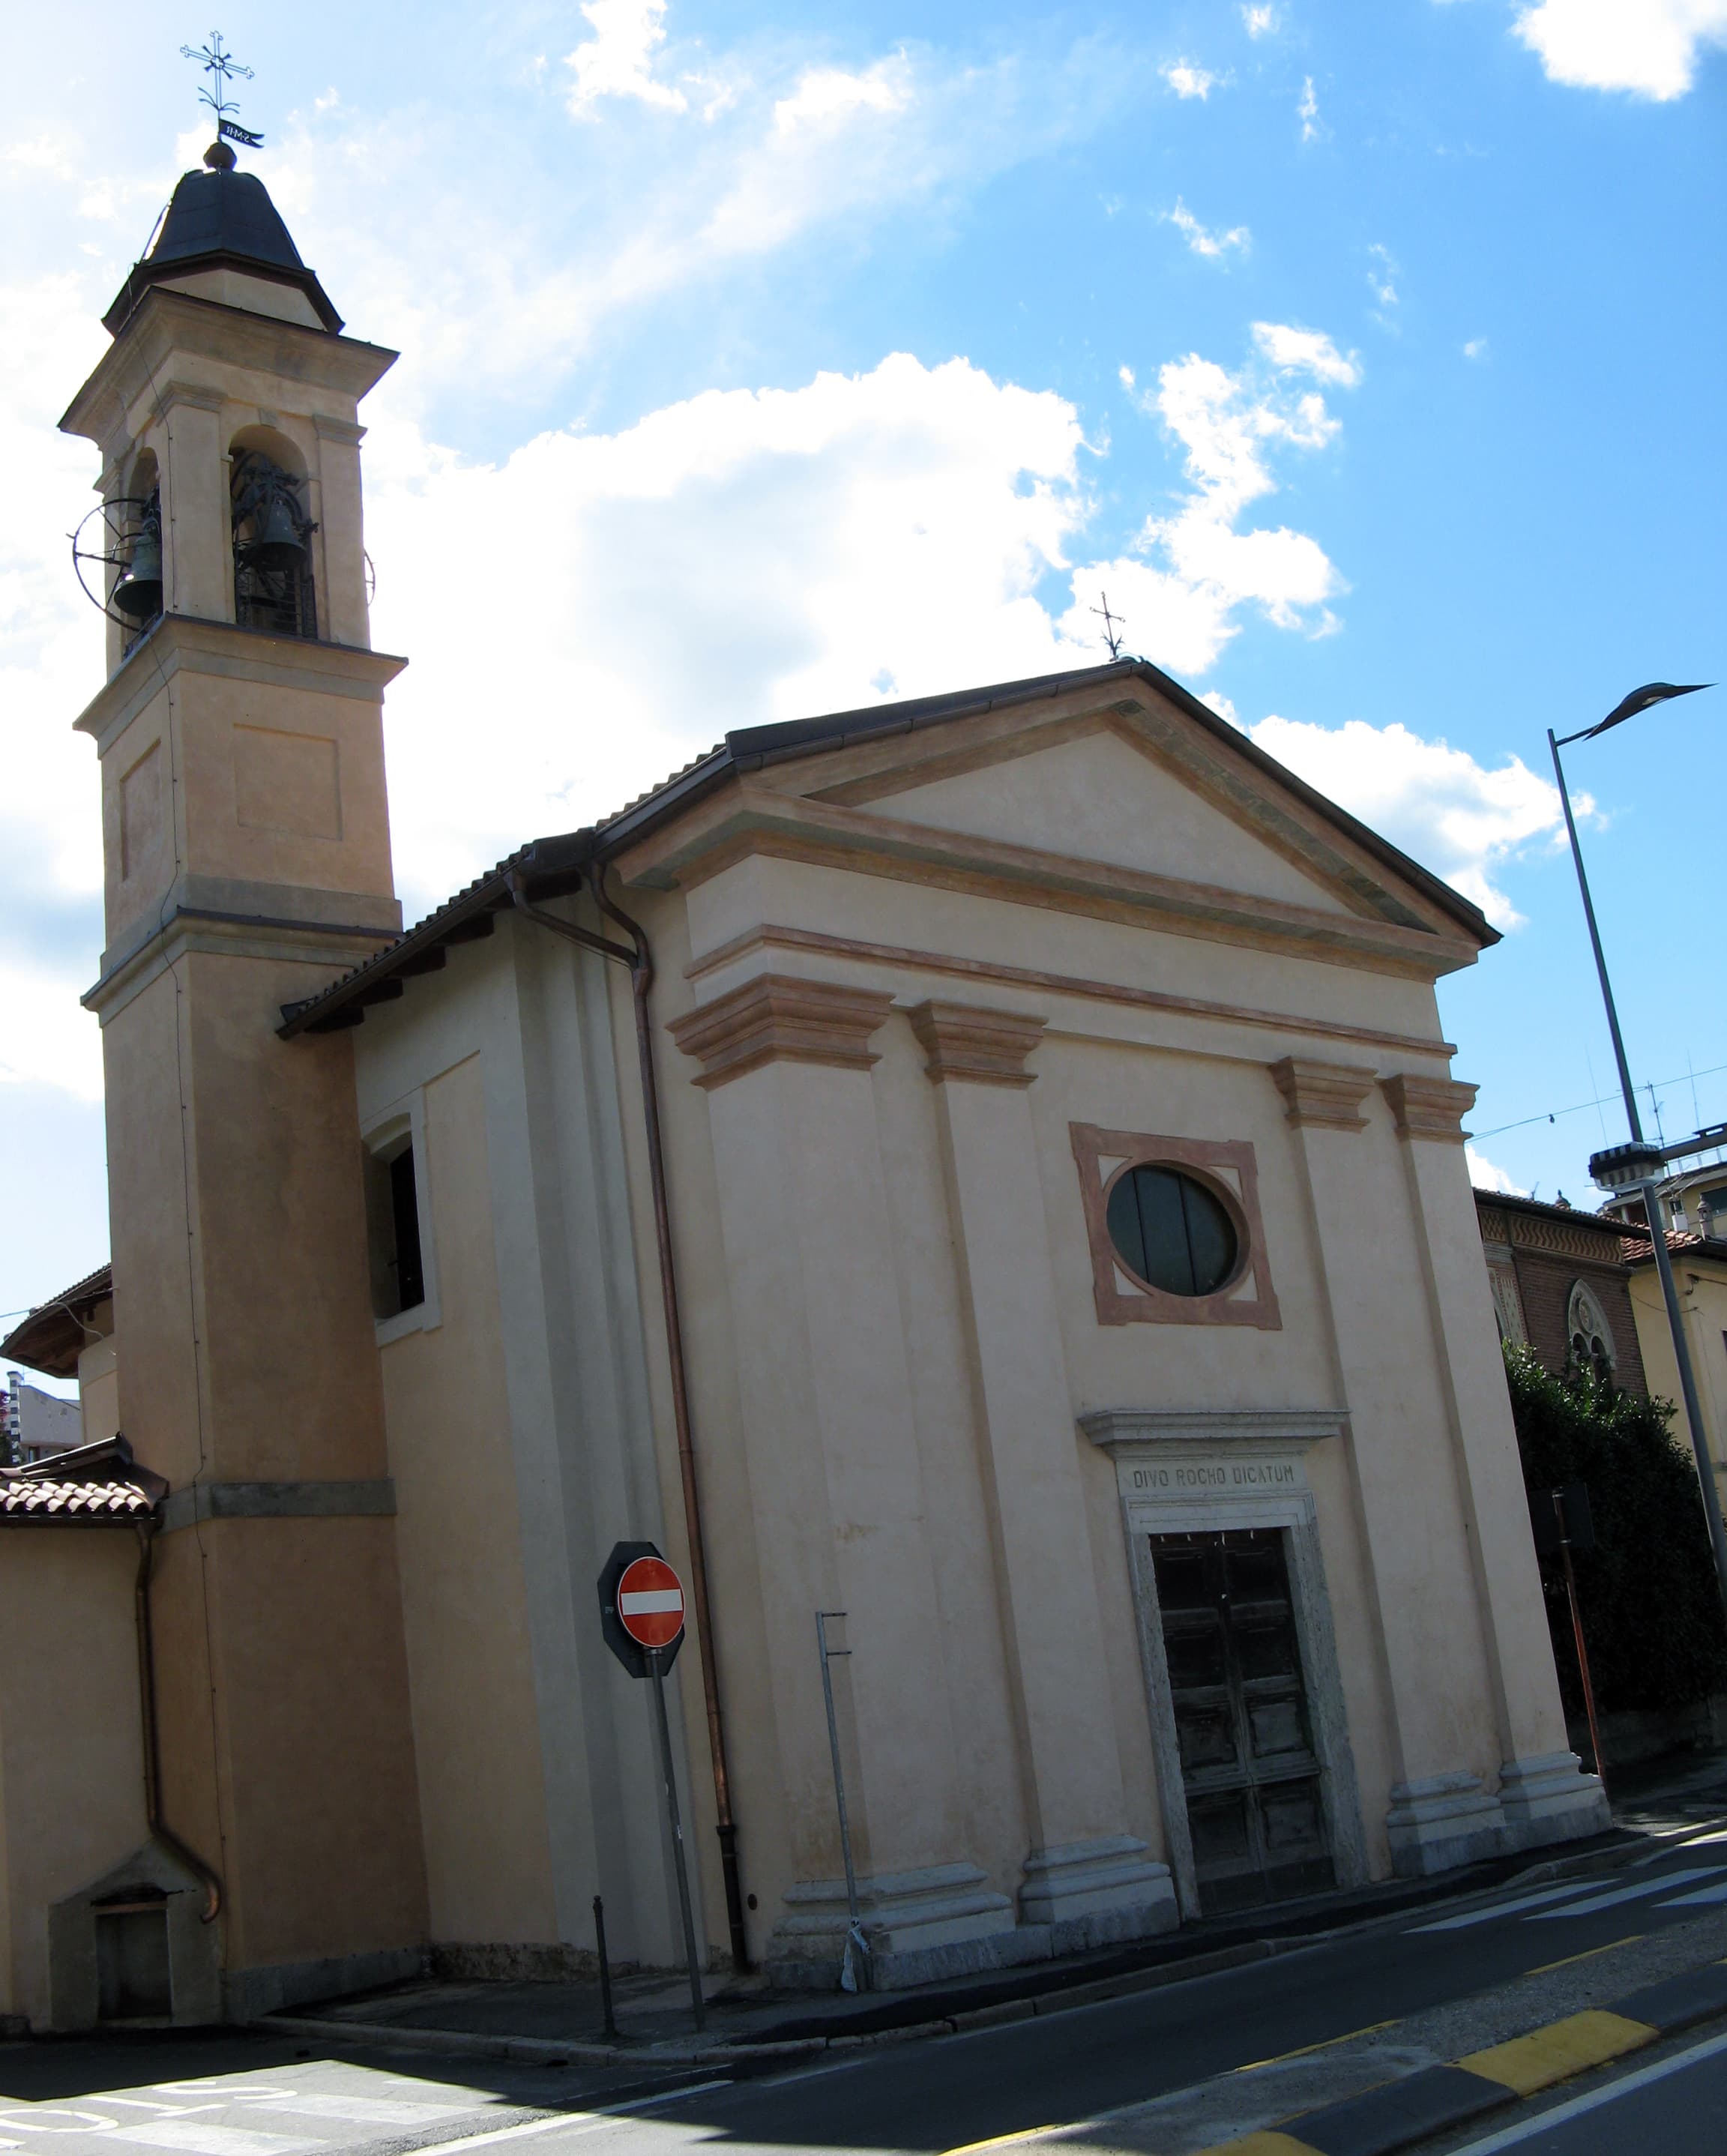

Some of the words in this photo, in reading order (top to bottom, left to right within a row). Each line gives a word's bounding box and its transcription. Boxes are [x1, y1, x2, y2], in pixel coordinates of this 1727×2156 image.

[1133, 1469, 1169, 1488] DIVO
[1176, 1467, 1226, 1486] ROCHO
[1232, 1465, 1295, 1484] DICATUM
[0, 2080, 298, 2149] STO
